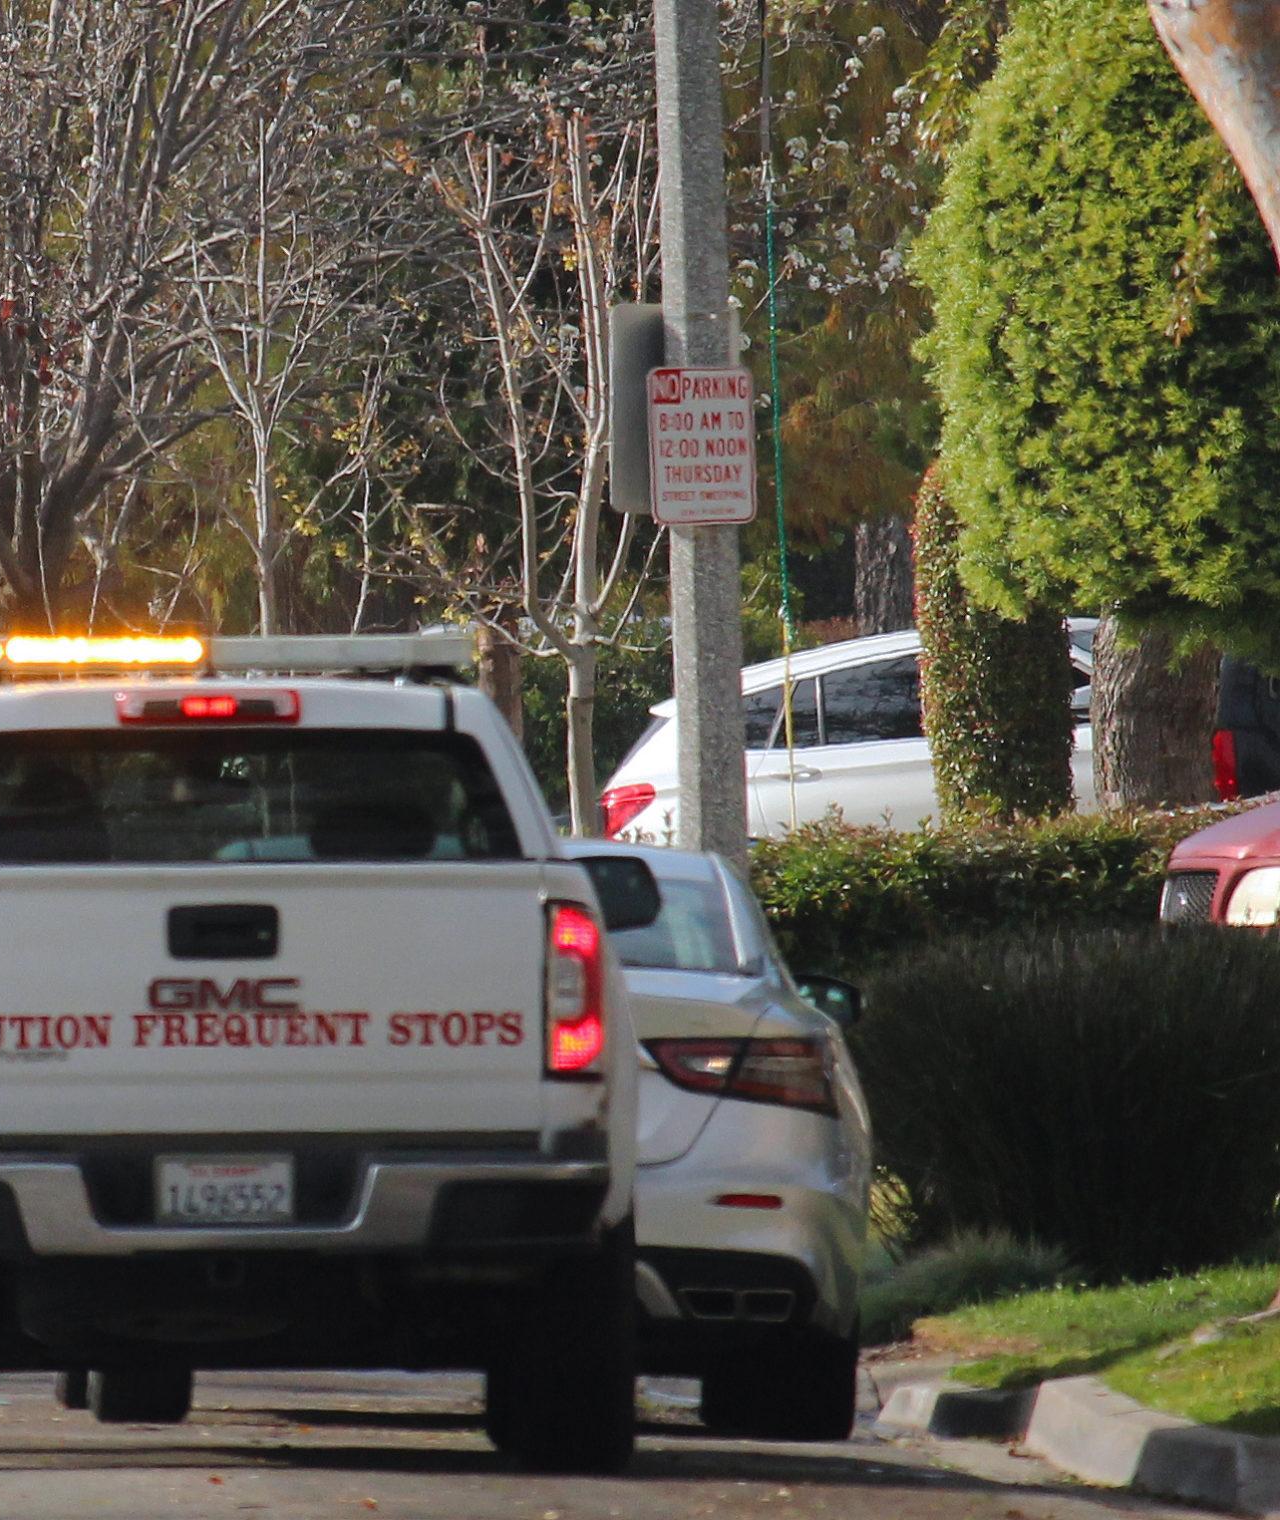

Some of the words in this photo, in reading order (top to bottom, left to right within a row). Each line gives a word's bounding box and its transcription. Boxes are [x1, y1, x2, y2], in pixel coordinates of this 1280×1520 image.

[653, 375, 680, 400] NO
[681, 376, 748, 400] PARKING
[660, 412, 694, 431] 8:00
[701, 412, 721, 430] AM
[728, 411, 745, 430] TO
[660, 438, 699, 458] 12:00
[706, 438, 747, 456] NOON
[664, 464, 742, 483] THURSDAY
[148, 977, 300, 1012] GMC
[133, 1012, 370, 1048] FREQUENT
[388, 1011, 525, 1047] STOPS
